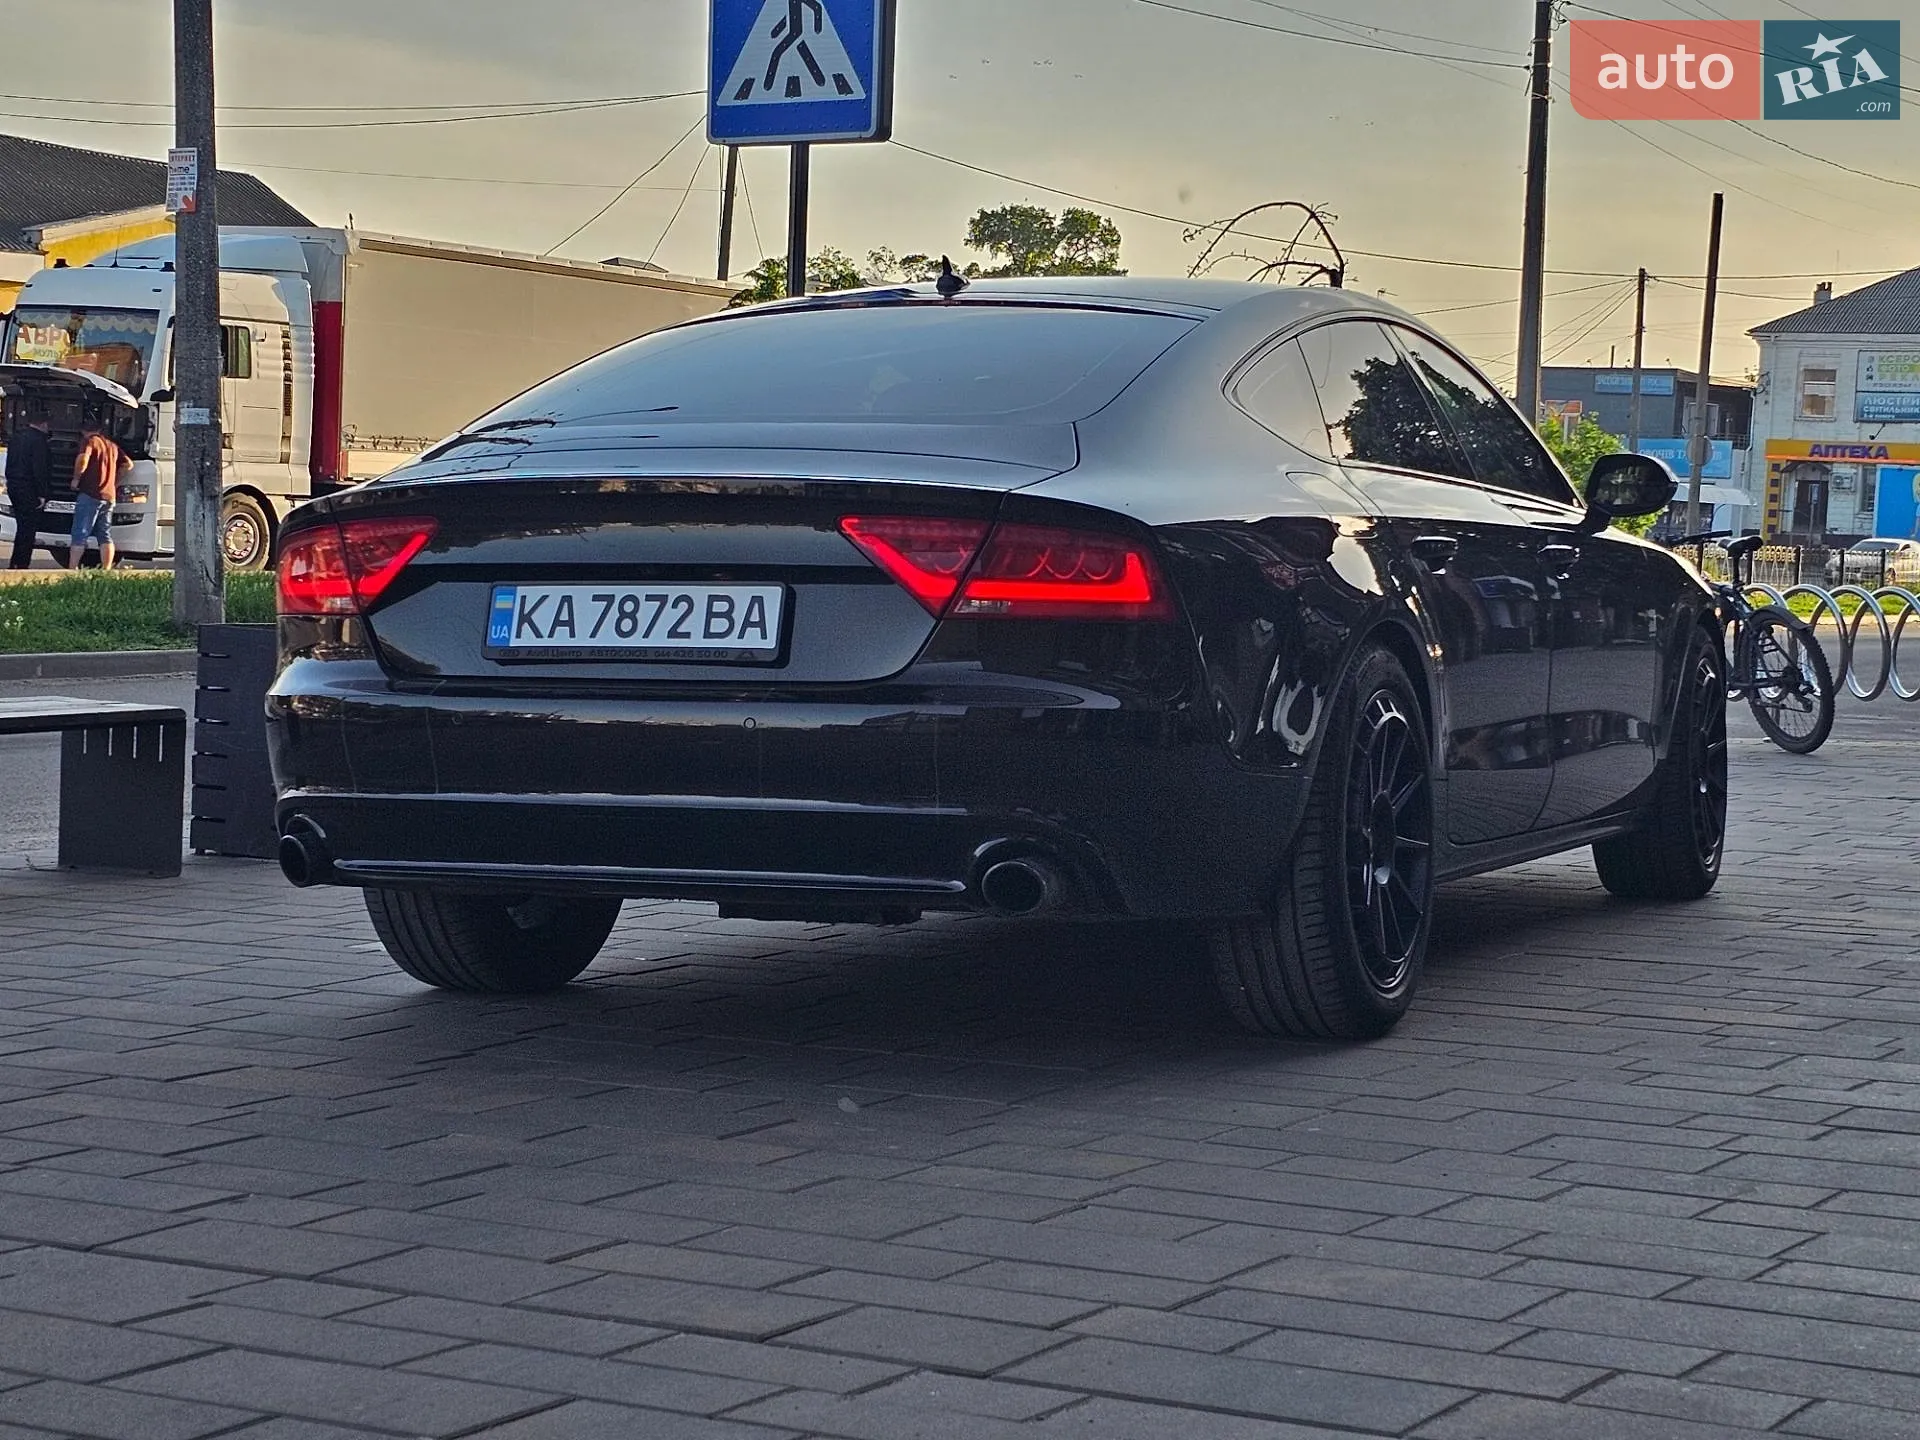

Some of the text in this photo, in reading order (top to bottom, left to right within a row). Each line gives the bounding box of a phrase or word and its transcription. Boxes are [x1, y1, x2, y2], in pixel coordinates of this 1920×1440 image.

[1808, 444, 1888, 459] АПТЕКА
[515, 593, 768, 640] KA 7872 BA
[491, 626, 510, 639] UA
